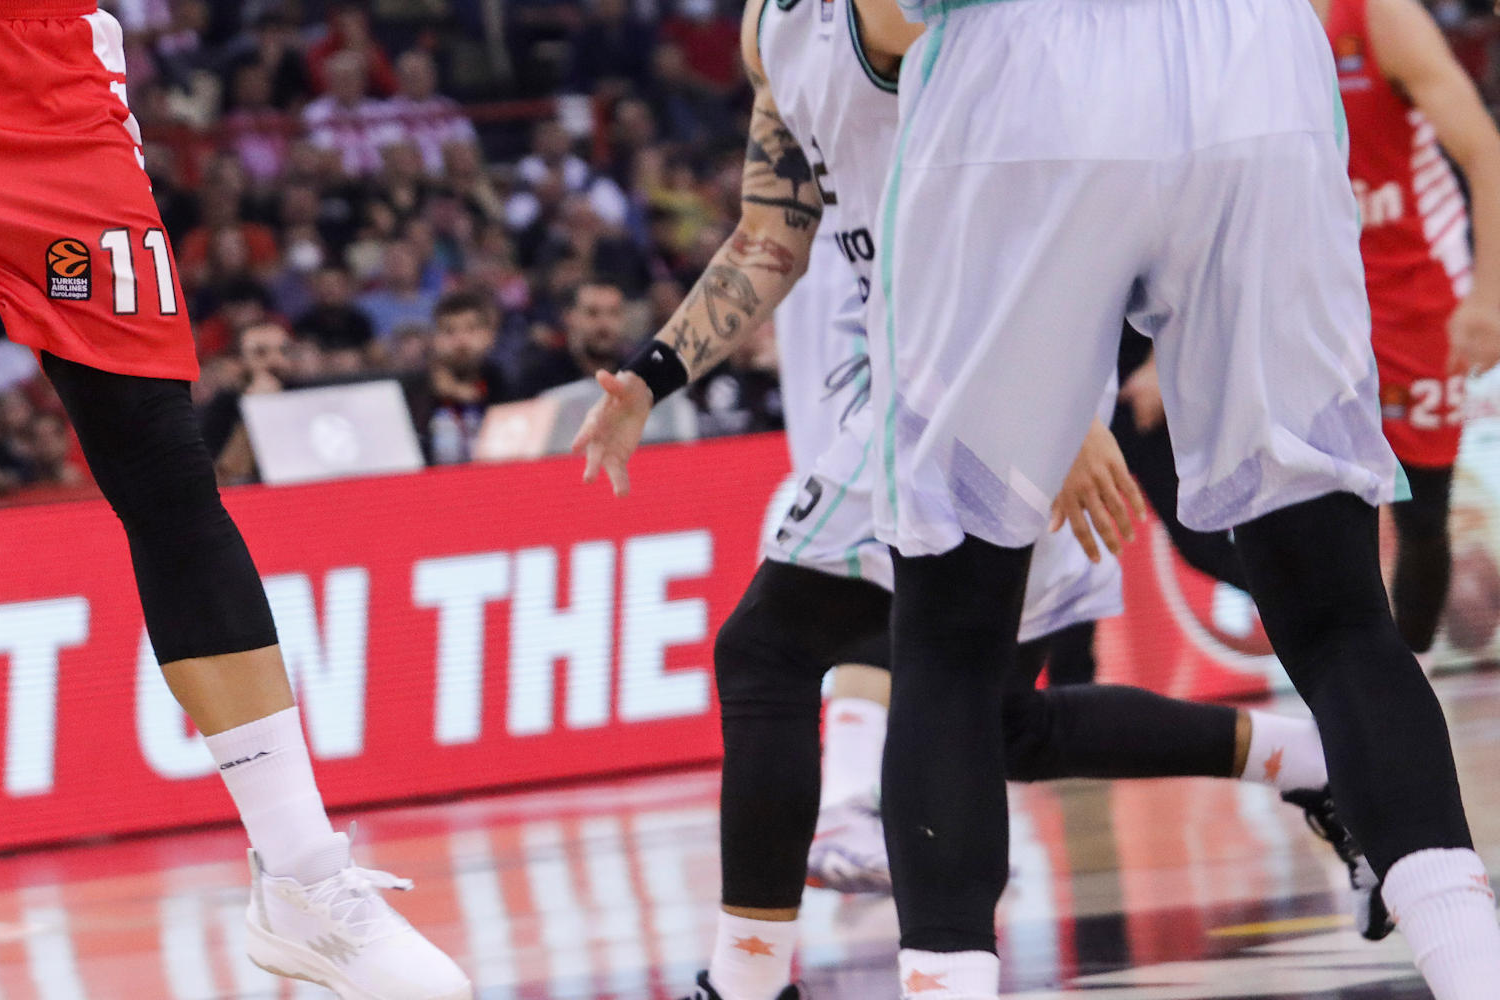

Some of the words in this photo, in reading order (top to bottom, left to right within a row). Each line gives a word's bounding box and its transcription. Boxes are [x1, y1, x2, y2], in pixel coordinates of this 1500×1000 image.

[99, 227, 178, 315] 11
[51, 277, 88, 285] TURKISH
[51, 284, 88, 292] AIRLINES
[50, 290, 88, 299] EuroLeague
[411, 529, 715, 747] THE
